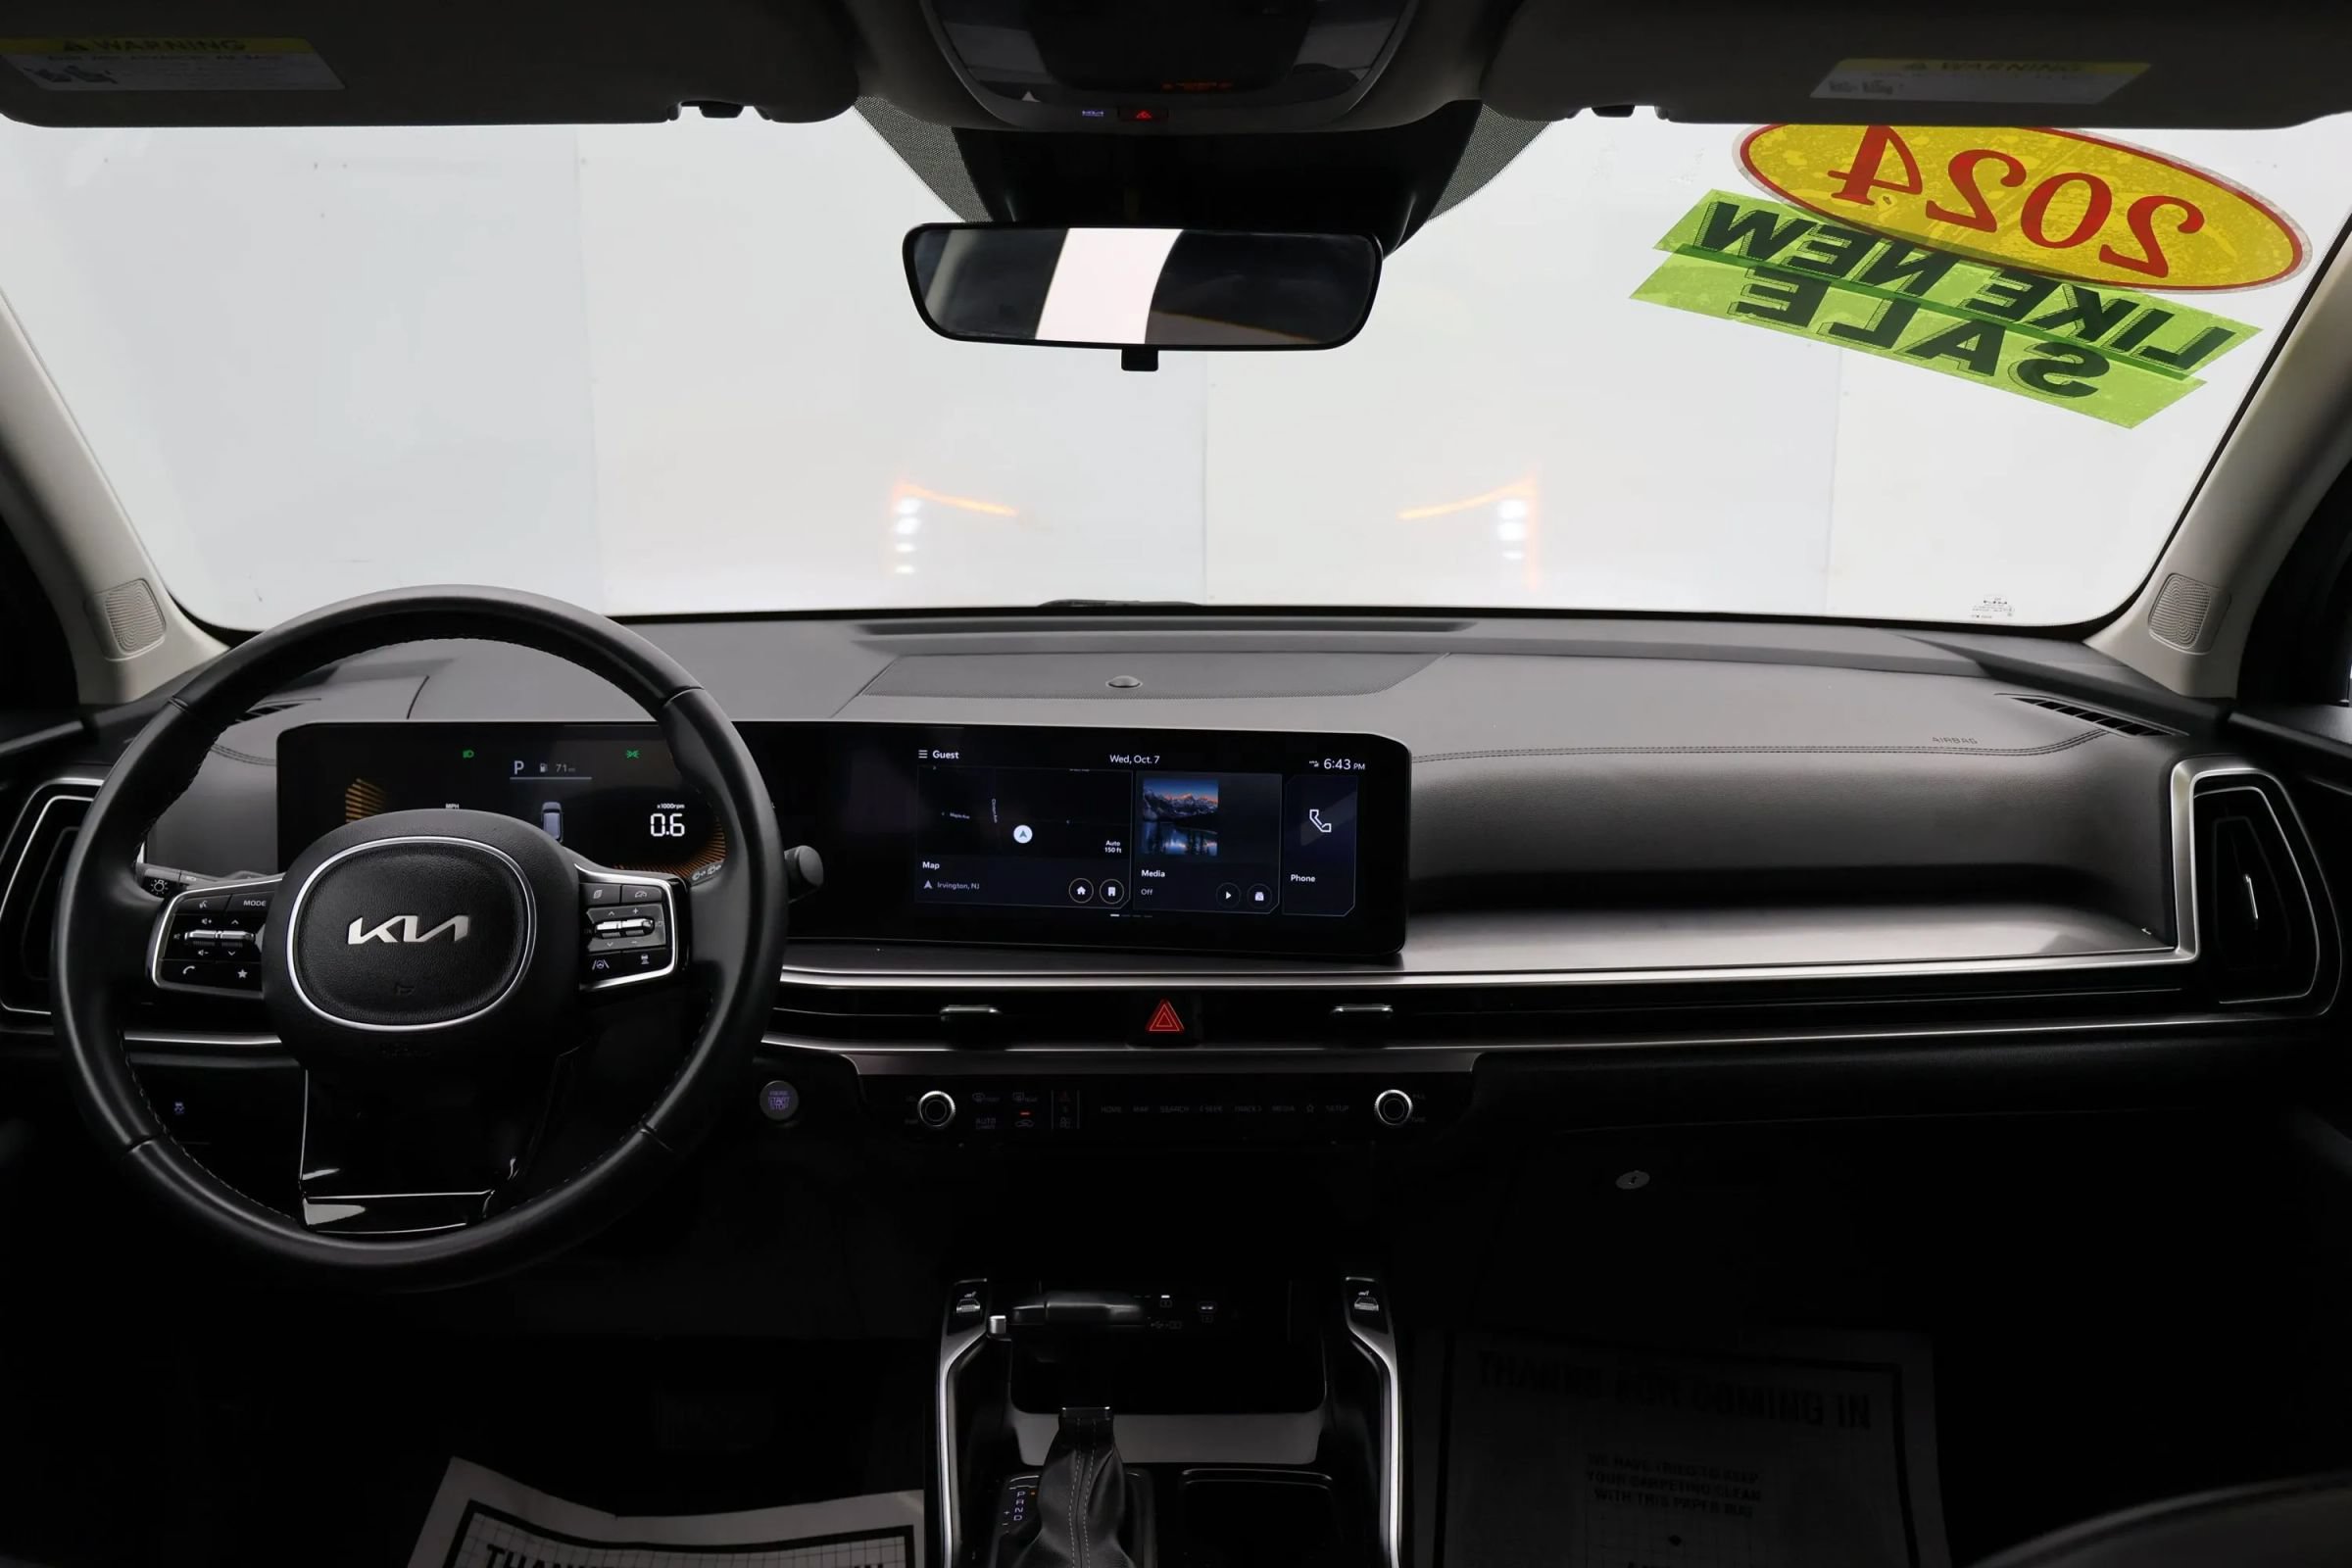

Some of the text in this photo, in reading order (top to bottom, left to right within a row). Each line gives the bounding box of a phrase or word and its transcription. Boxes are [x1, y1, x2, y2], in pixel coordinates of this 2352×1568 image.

[93, 38, 246, 51] WARNING
[1940, 61, 2082, 73] WARNING
[932, 750, 959, 760] Guest
[1109, 754, 1160, 764] Wed, Oct. 7
[514, 760, 524, 775] P
[556, 763, 567, 772] 71
[1323, 758, 1351, 770] 6:43
[649, 812, 686, 837] 0.6
[922, 860, 940, 871] Map
[1290, 874, 1316, 883] Phone
[937, 881, 970, 891] Irvington,
[348, 914, 469, 945] KIA
[1692, 1379, 1824, 1428] COMING
[1838, 1391, 1871, 1430] IN
[1615, 1455, 1647, 1470] HAVE
[1588, 1471, 1626, 1485] YOUR
[1717, 1484, 1762, 1501] CLEAN
[1594, 1488, 1632, 1503] WITH
[1639, 1492, 1669, 1507] THIS
[1674, 1496, 1719, 1514] PAPER
